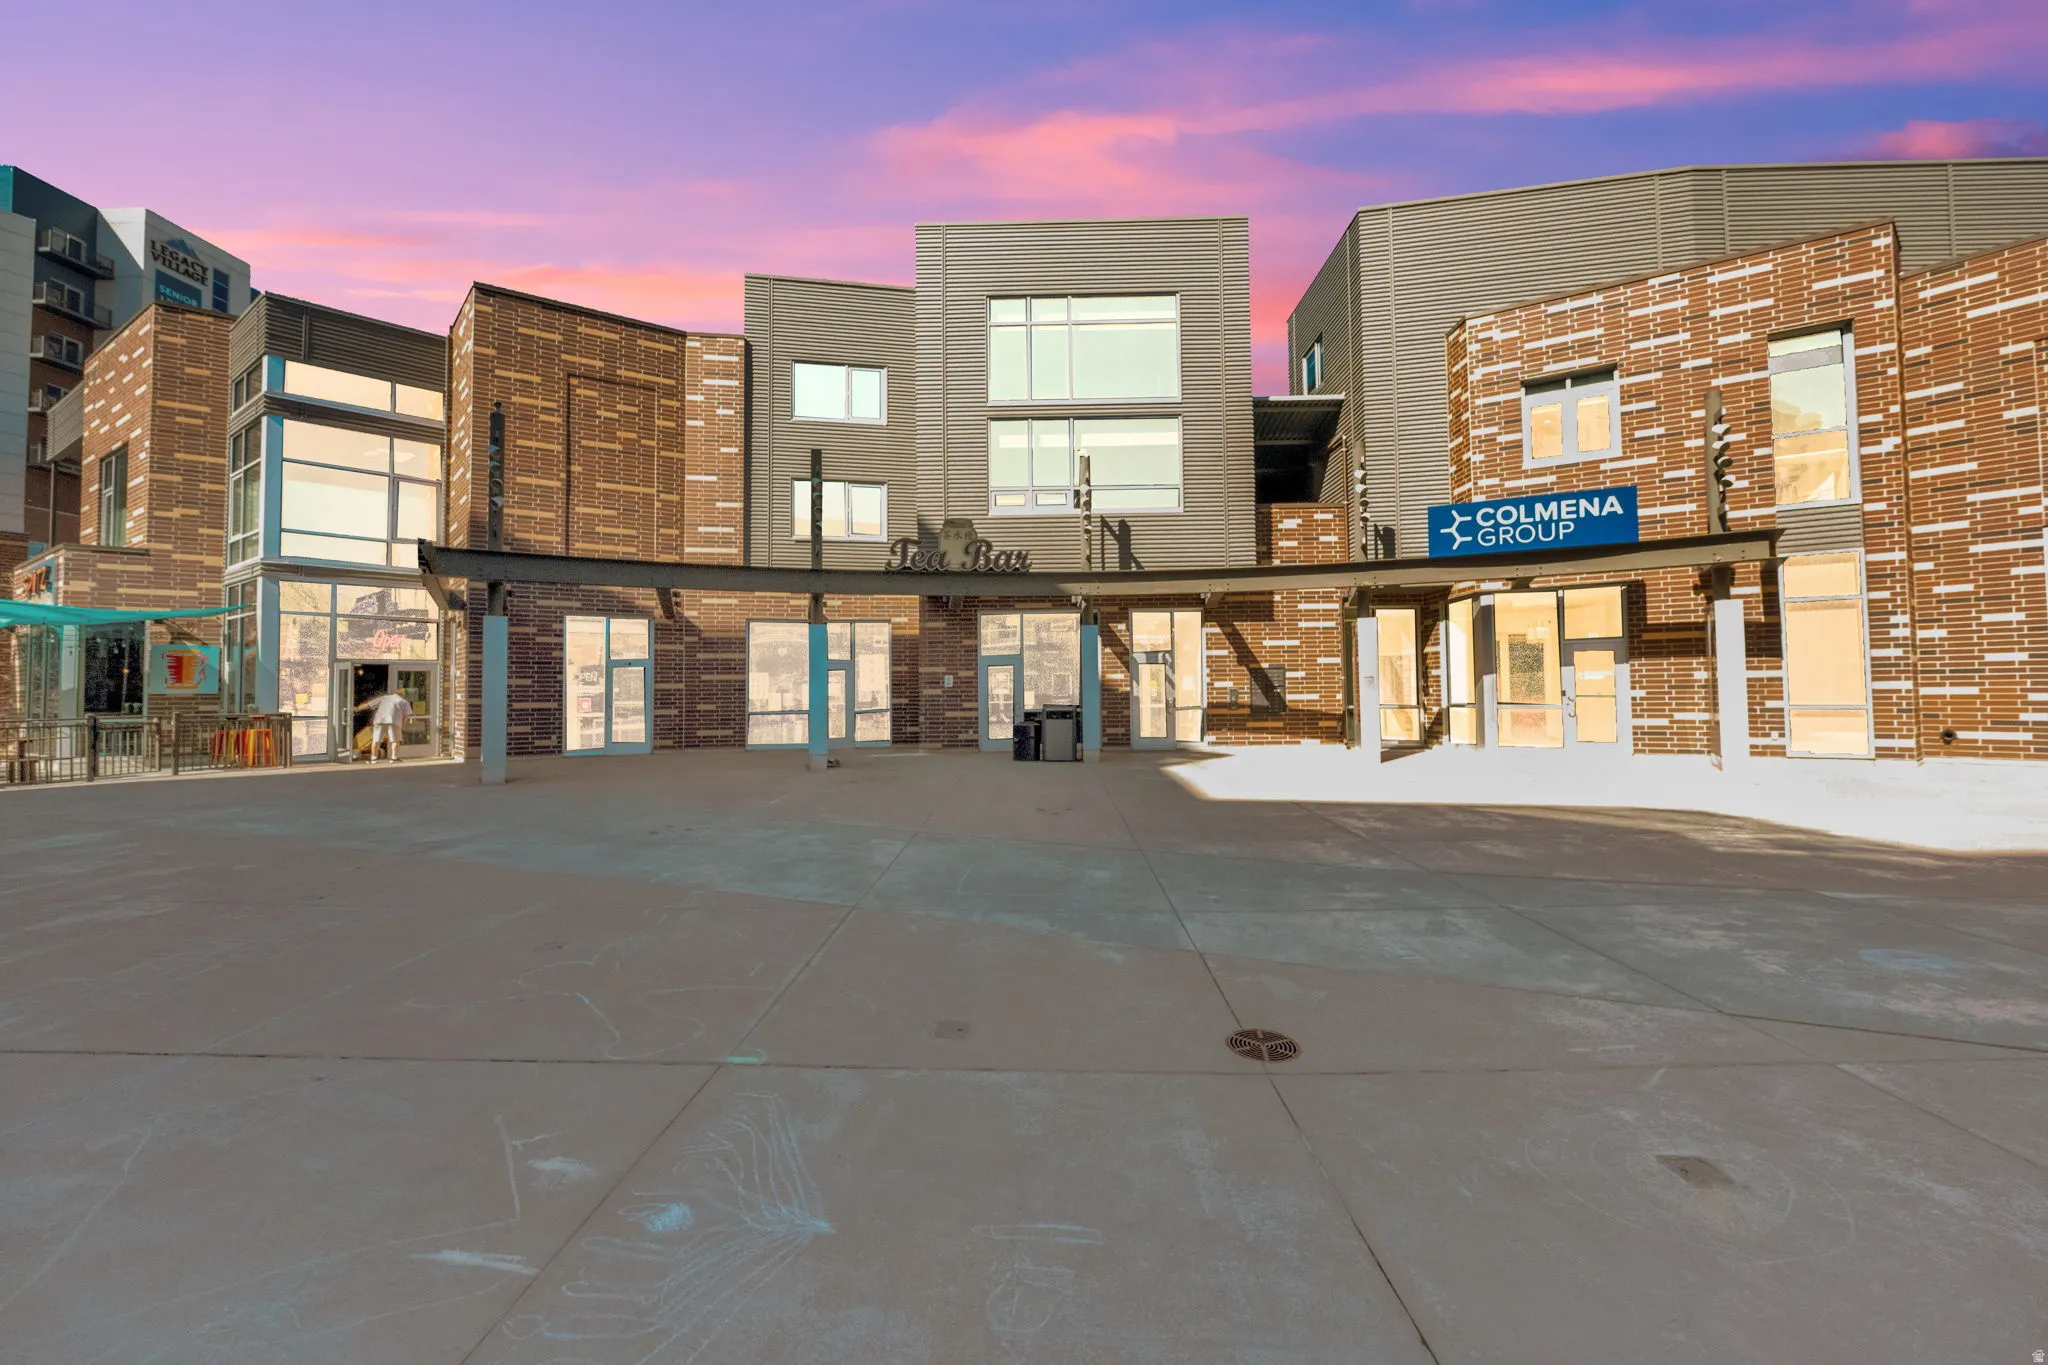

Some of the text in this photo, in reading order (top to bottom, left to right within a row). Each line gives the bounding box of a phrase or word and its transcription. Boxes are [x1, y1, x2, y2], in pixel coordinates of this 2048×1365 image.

[151, 240, 208, 276] LEGACY
[151, 251, 208, 287] VILLAGE
[159, 284, 198, 307] SENIOR
[1476, 495, 1624, 527] COLMENA
[1477, 521, 1575, 547] GROUP
[885, 538, 1033, 572] Tea Bar
[373, 631, 404, 649] Open
